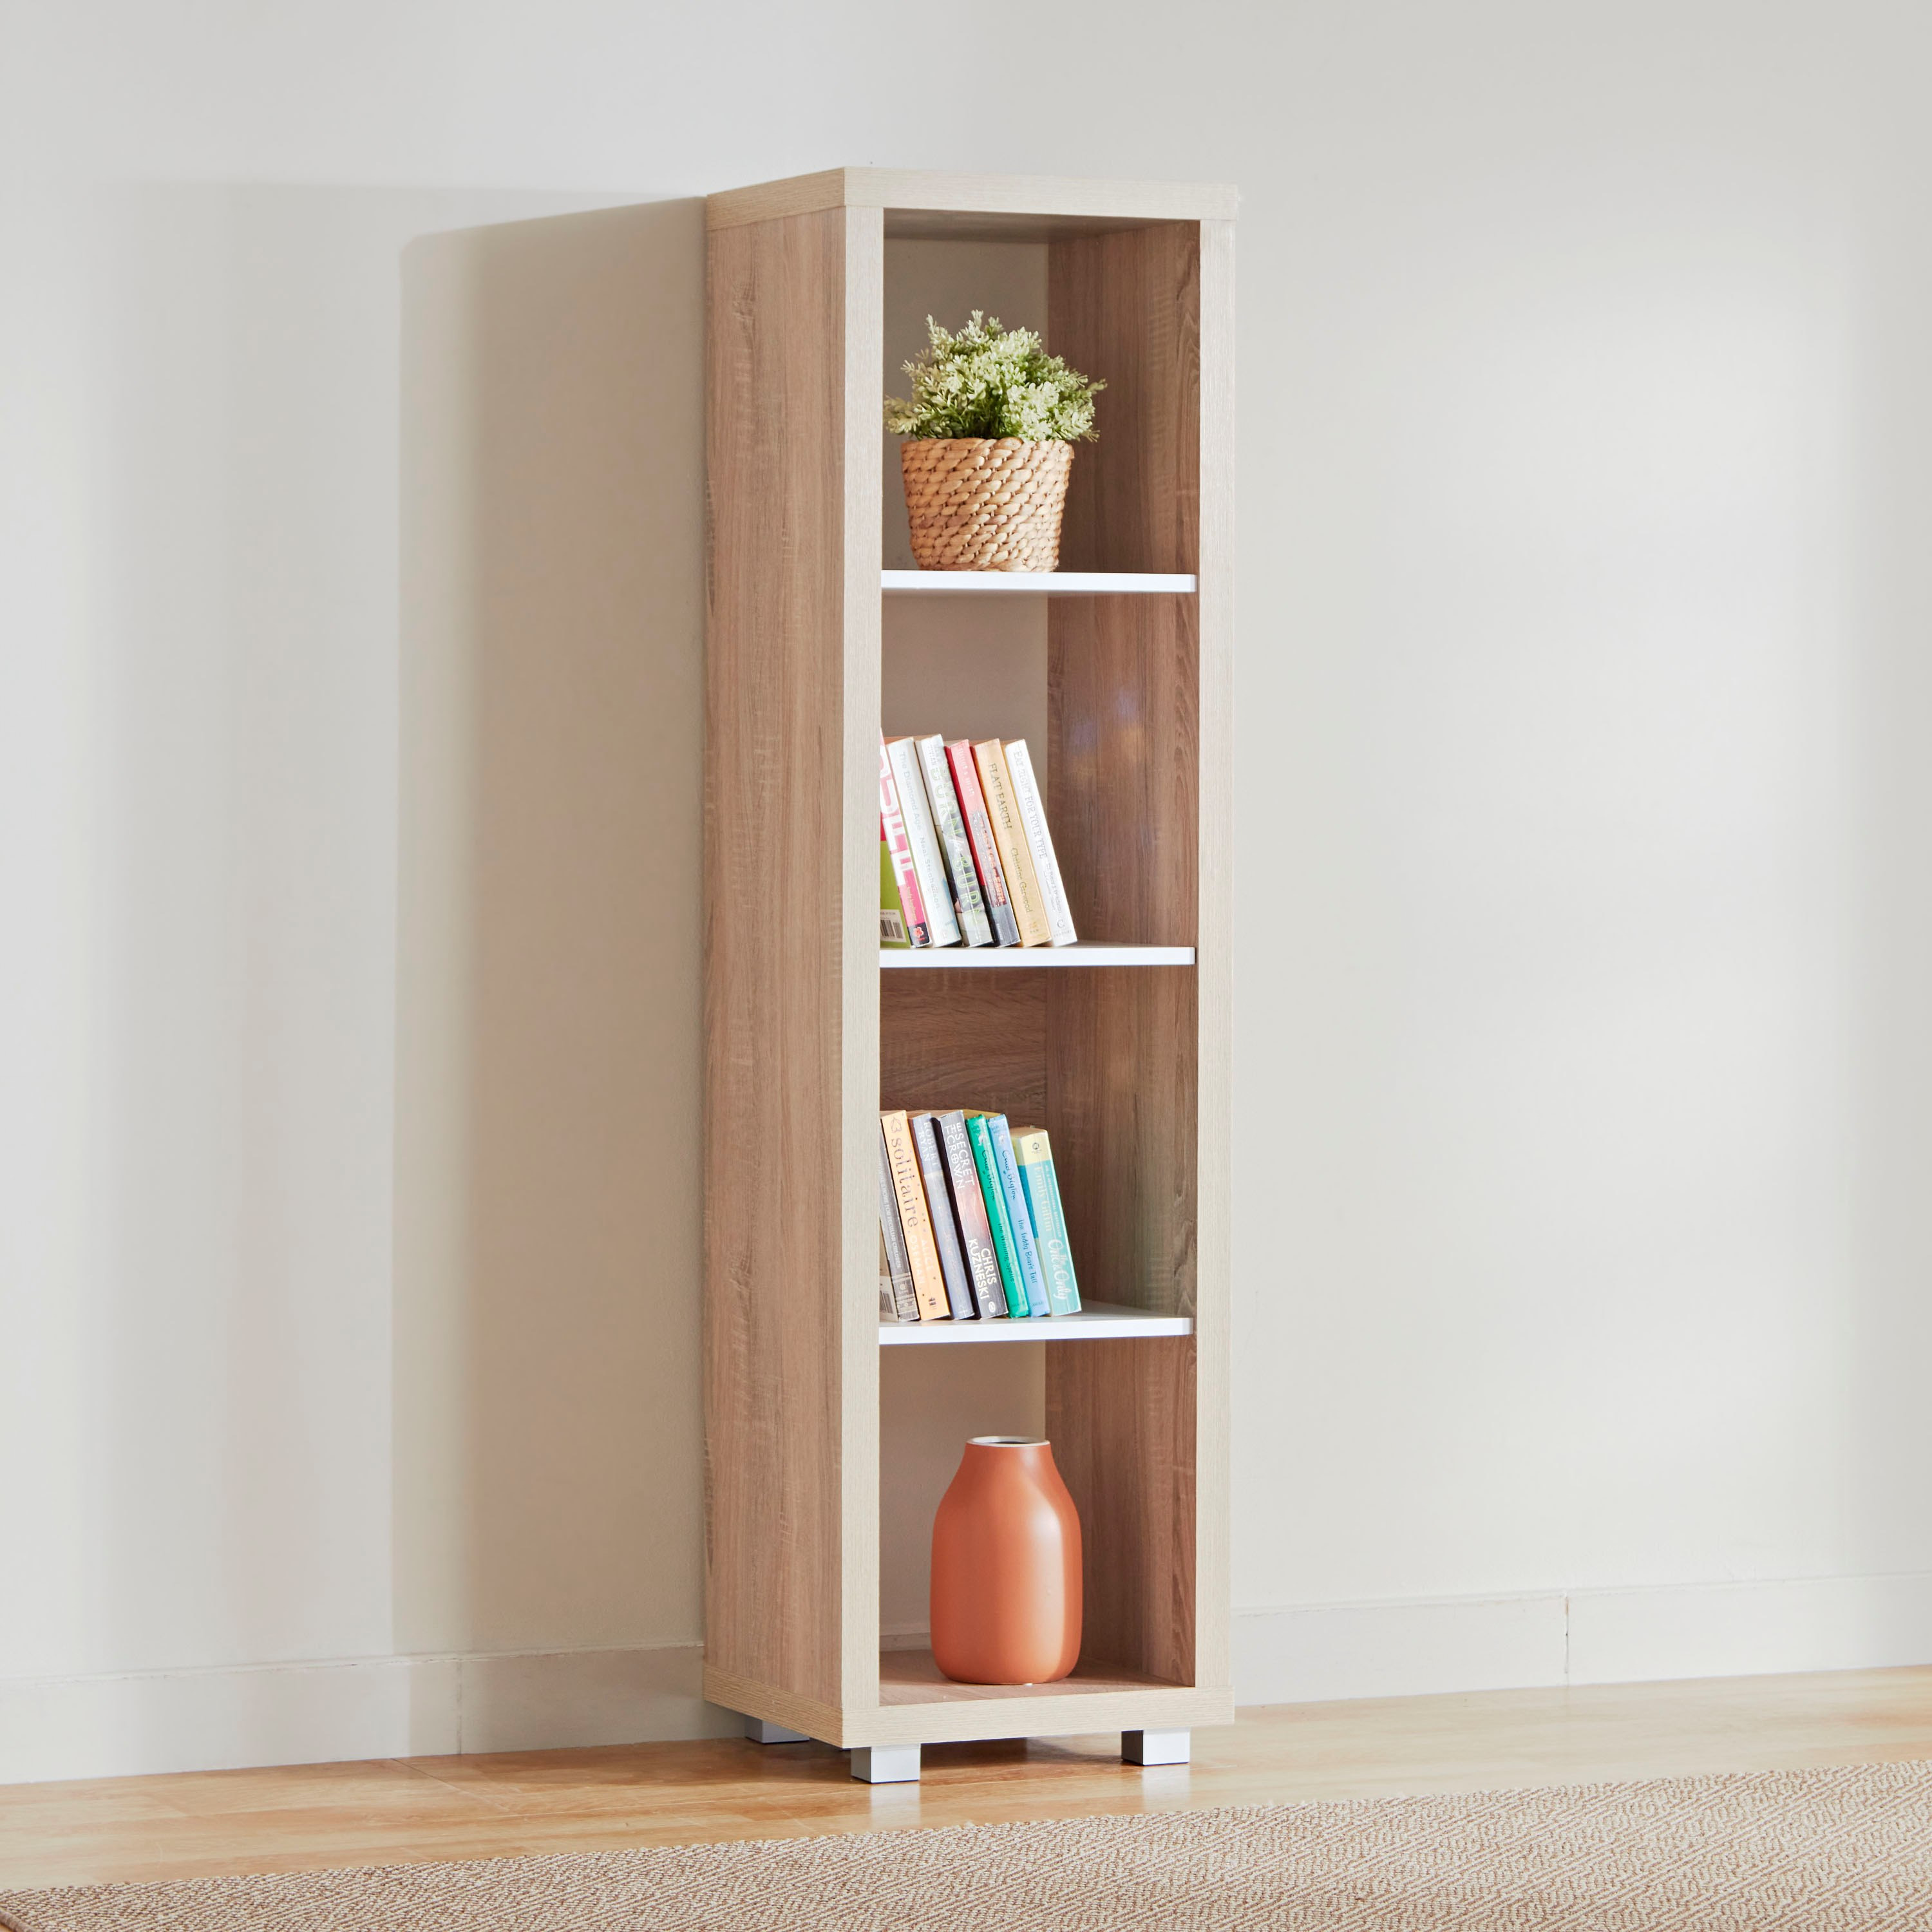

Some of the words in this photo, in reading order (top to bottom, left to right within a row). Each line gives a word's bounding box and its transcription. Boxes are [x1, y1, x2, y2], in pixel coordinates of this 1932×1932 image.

[904, 772, 918, 810] Diamond
[913, 813, 922, 830] Age
[989, 763, 1001, 790] FLAT
[996, 793, 1012, 829] EARTH
[1025, 796, 1036, 813] FOR
[1029, 814, 1042, 837] YOUR
[1036, 838, 1048, 859] TYPE
[1010, 848, 1023, 880] Christine
[1019, 881, 1032, 912] Garwood
[923, 1122, 938, 1166] ROBERT
[944, 1122, 961, 1133] THE
[919, 1132, 929, 1161] RYAN
[947, 1135, 964, 1188] CROWN
[956, 1133, 974, 1185] SECRET
[1002, 1150, 1012, 1170] Enid
[891, 1137, 919, 1227] solitaire
[1006, 1173, 1018, 1200] Blyton
[1034, 1166, 1046, 1198] Emily
[1041, 1200, 1054, 1231] Giffin
[892, 1242, 900, 1267] CHILDREN
[909, 1235, 925, 1283] OSEMAN
[921, 1240, 933, 1270] ALICE
[969, 1238, 989, 1299] KUZNESKI
[981, 1248, 996, 1284] CHRIS
[1020, 1232, 1028, 1250] Teddy
[1025, 1251, 1034, 1269] Bear's
[1048, 1238, 1064, 1264] One
[1053, 1270, 1072, 1300] Only
